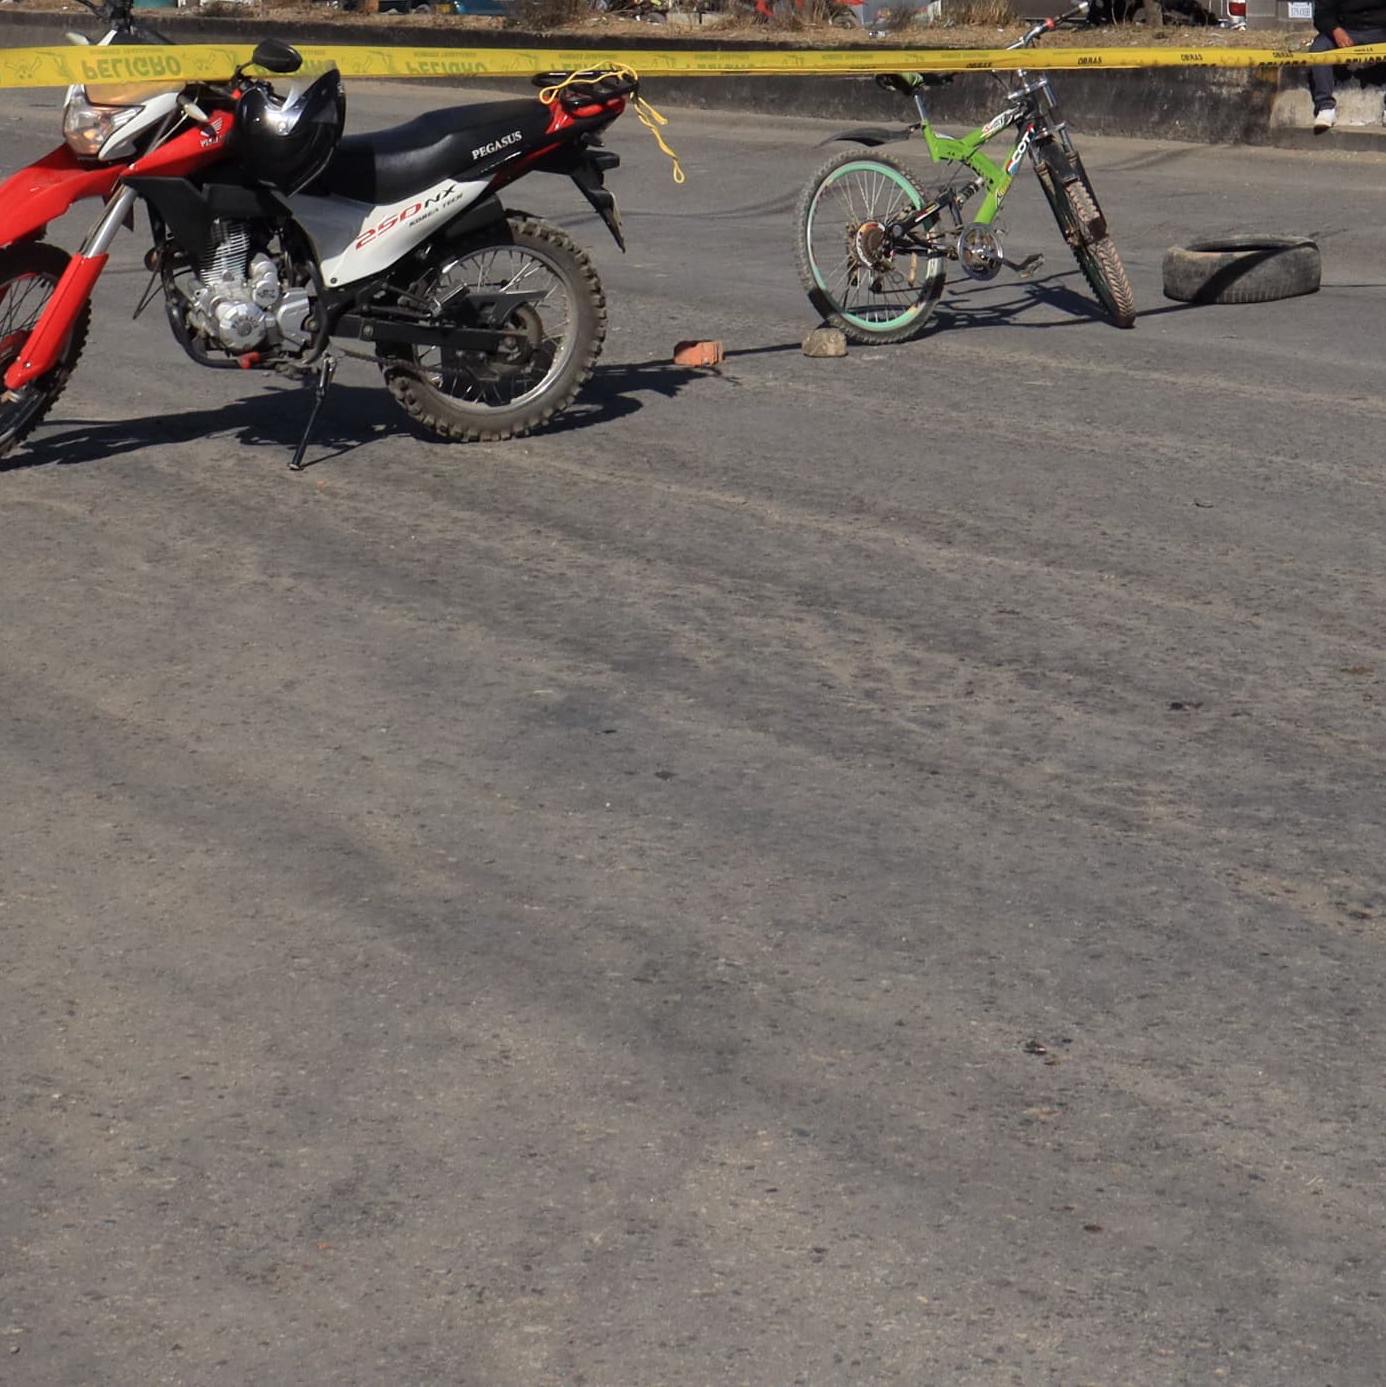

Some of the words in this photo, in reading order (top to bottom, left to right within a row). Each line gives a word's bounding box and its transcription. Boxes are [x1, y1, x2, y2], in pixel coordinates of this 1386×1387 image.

[1180, 53, 1203, 62] OBRAS
[1272, 49, 1294, 59] OBRAS
[1077, 56, 1103, 66] OBRAS
[471, 130, 523, 160] PEGASUS
